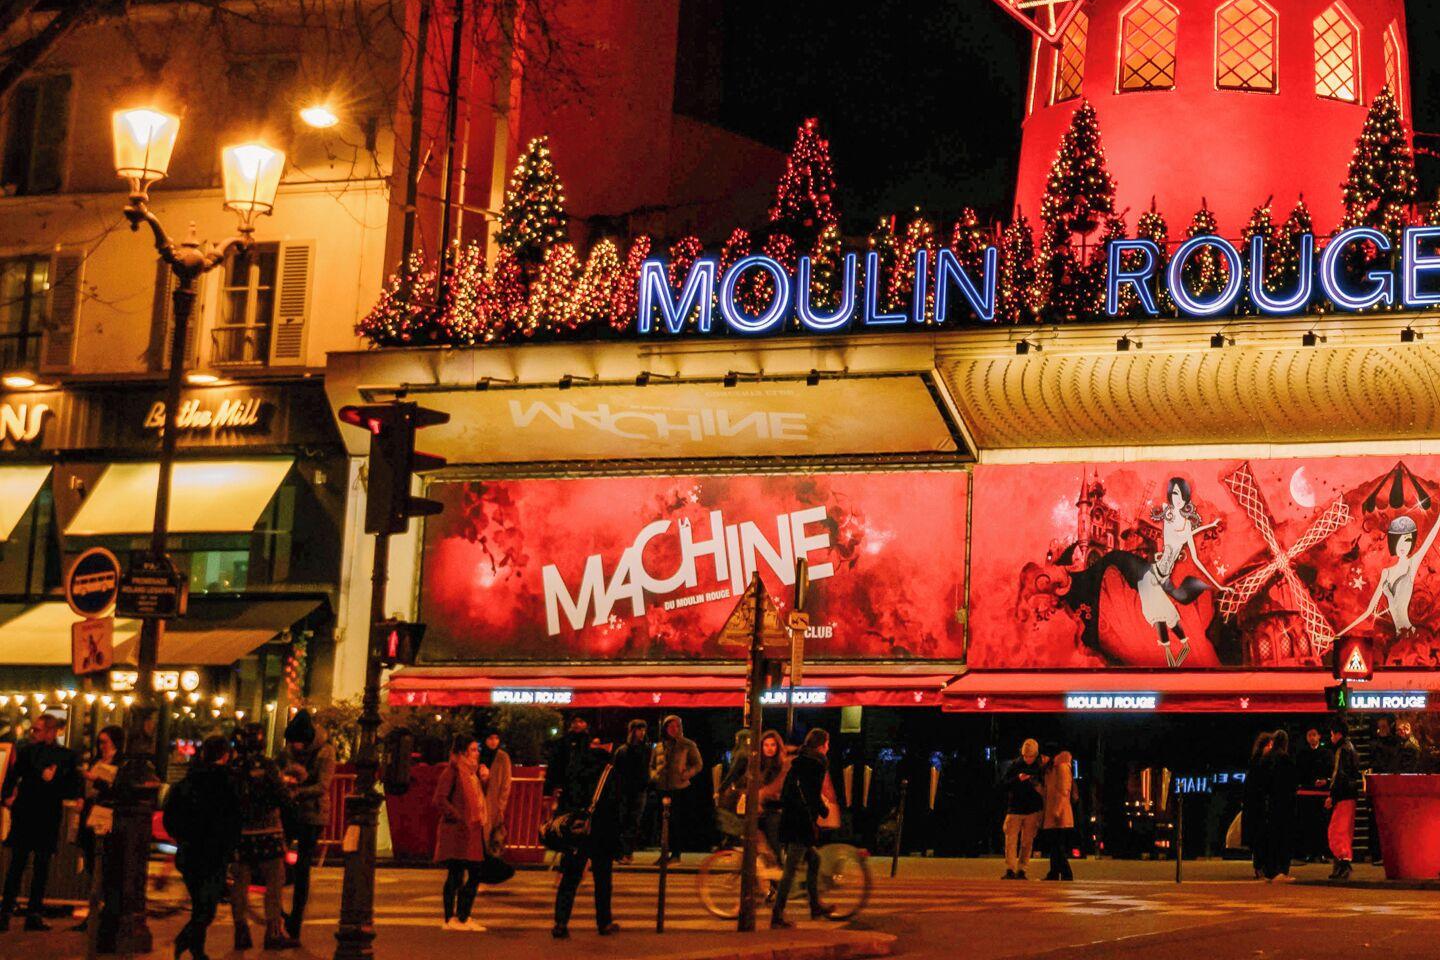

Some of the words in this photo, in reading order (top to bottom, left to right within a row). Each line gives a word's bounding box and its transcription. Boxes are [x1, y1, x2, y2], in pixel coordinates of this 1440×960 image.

[640, 246, 998, 334] MOULIN
[176, 399, 211, 428] the
[211, 397, 262, 428] Mill
[542, 505, 835, 637] MACHINE
[664, 600, 676, 611] DU
[676, 594, 705, 608] MOULIN
[705, 589, 731, 602] ROUGE
[803, 626, 833, 638] CLUB
[492, 690, 534, 704] MOULIN
[534, 691, 572, 704] ROUGE
[1066, 696, 1113, 709] MOULIN
[1113, 696, 1156, 709] ROUGE
[1382, 696, 1426, 709] ROUGE
